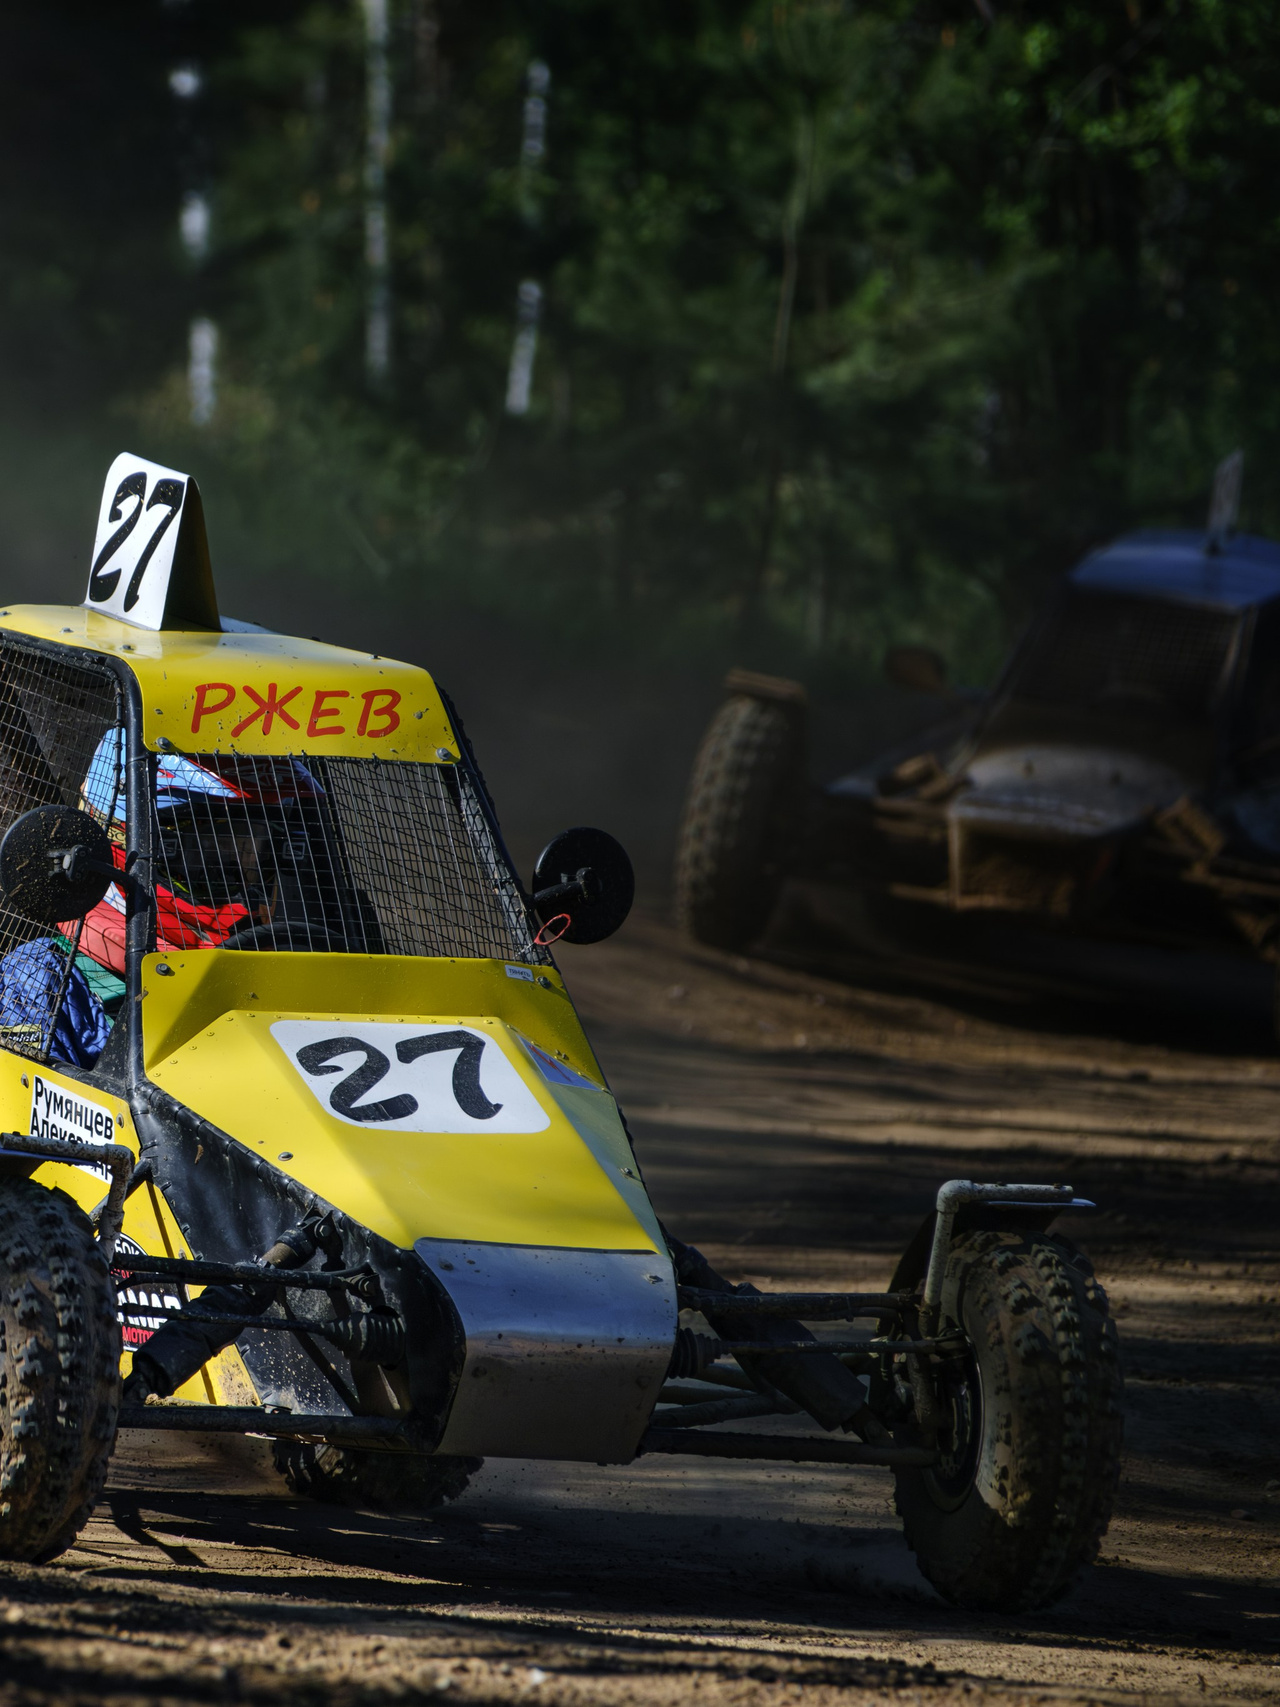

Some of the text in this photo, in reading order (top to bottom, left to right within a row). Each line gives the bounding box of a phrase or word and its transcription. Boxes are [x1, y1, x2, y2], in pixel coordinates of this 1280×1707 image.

[89, 471, 186, 613] 27
[190, 682, 402, 739] РЖЕВ
[34, 1076, 114, 1141] Румянцев
[296, 1030, 504, 1123] 27
